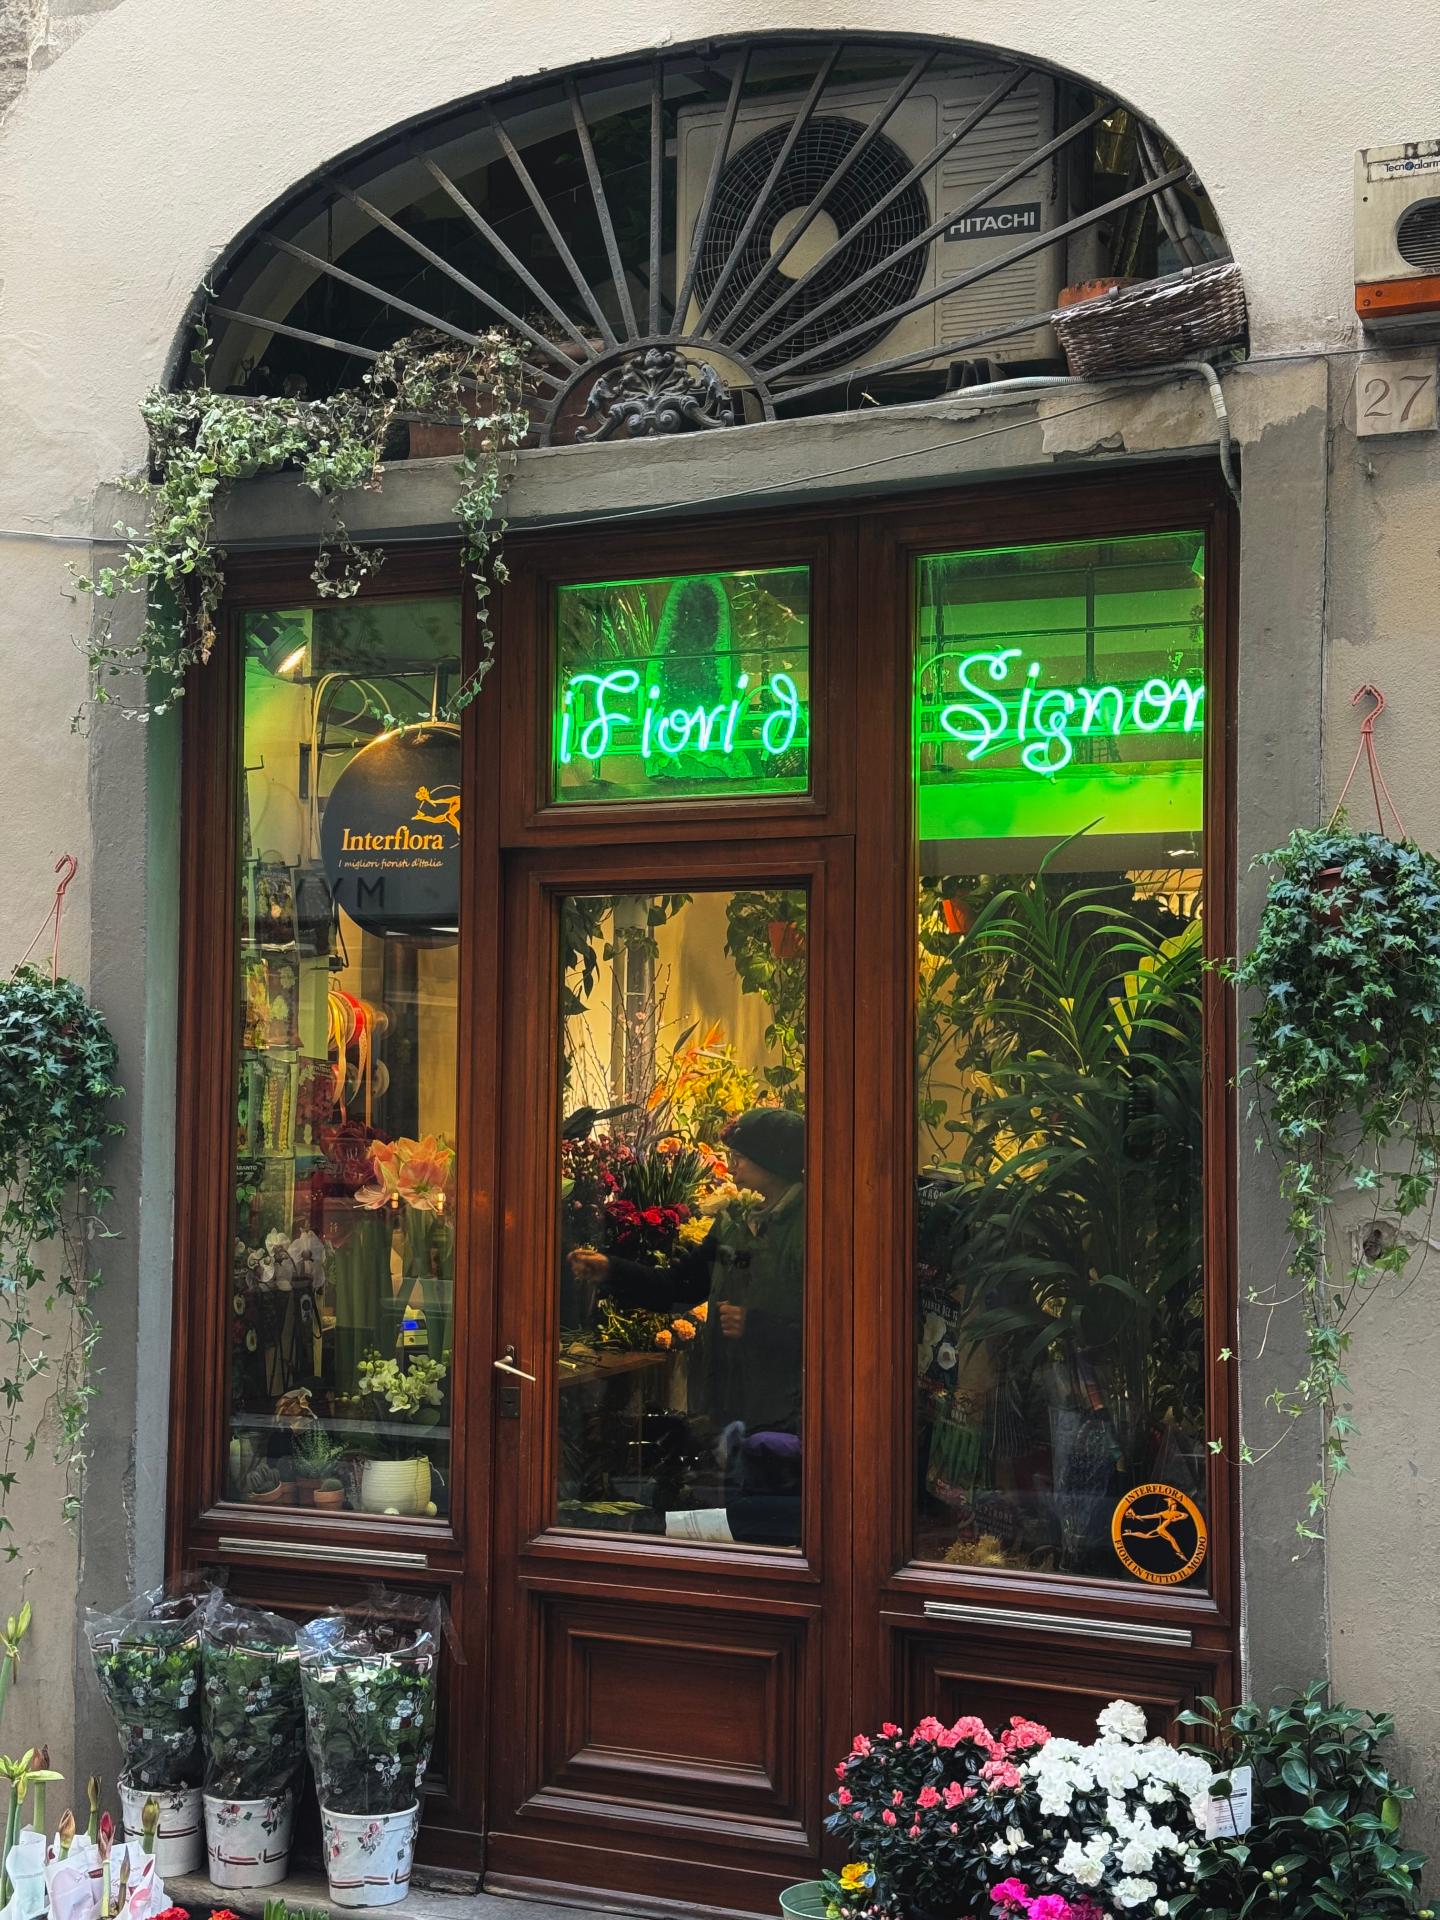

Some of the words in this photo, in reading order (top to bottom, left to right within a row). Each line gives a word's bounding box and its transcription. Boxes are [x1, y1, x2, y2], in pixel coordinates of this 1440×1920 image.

[950, 211, 1035, 235] HITACHI
[1363, 374, 1432, 423] 27
[341, 825, 444, 851] Interflora
[344, 858, 379, 870] migliori
[380, 858, 410, 870] fioristi
[411, 857, 443, 868] d'Italia
[1125, 1485, 1184, 1504] INTERFLORA
[1114, 1539, 1134, 1568] FIORI
[1133, 1566, 1142, 1577] IN
[1145, 1571, 1177, 1583] TUTTO
[1180, 1569, 1190, 1579] IL
[1190, 1536, 1207, 1572] MONDO
